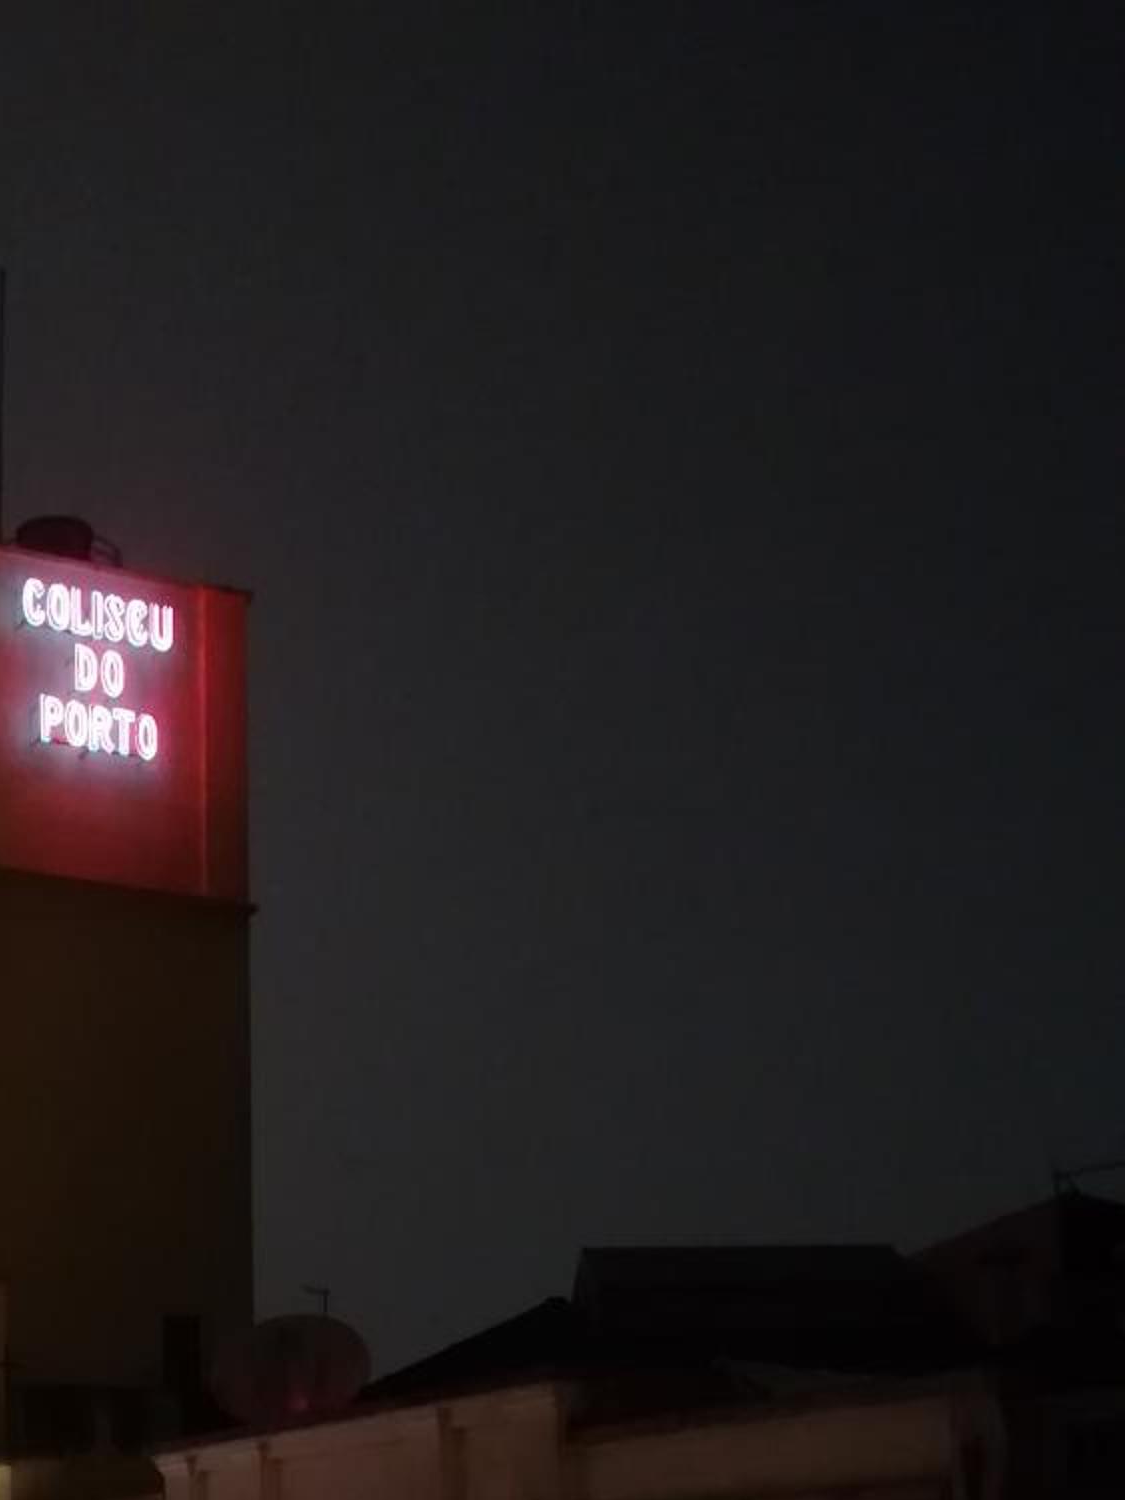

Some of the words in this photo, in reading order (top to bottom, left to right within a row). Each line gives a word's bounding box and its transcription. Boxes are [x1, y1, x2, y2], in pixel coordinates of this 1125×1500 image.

[22, 577, 174, 652] COLISEU
[74, 643, 125, 698] DO
[39, 693, 158, 761] PORTO
